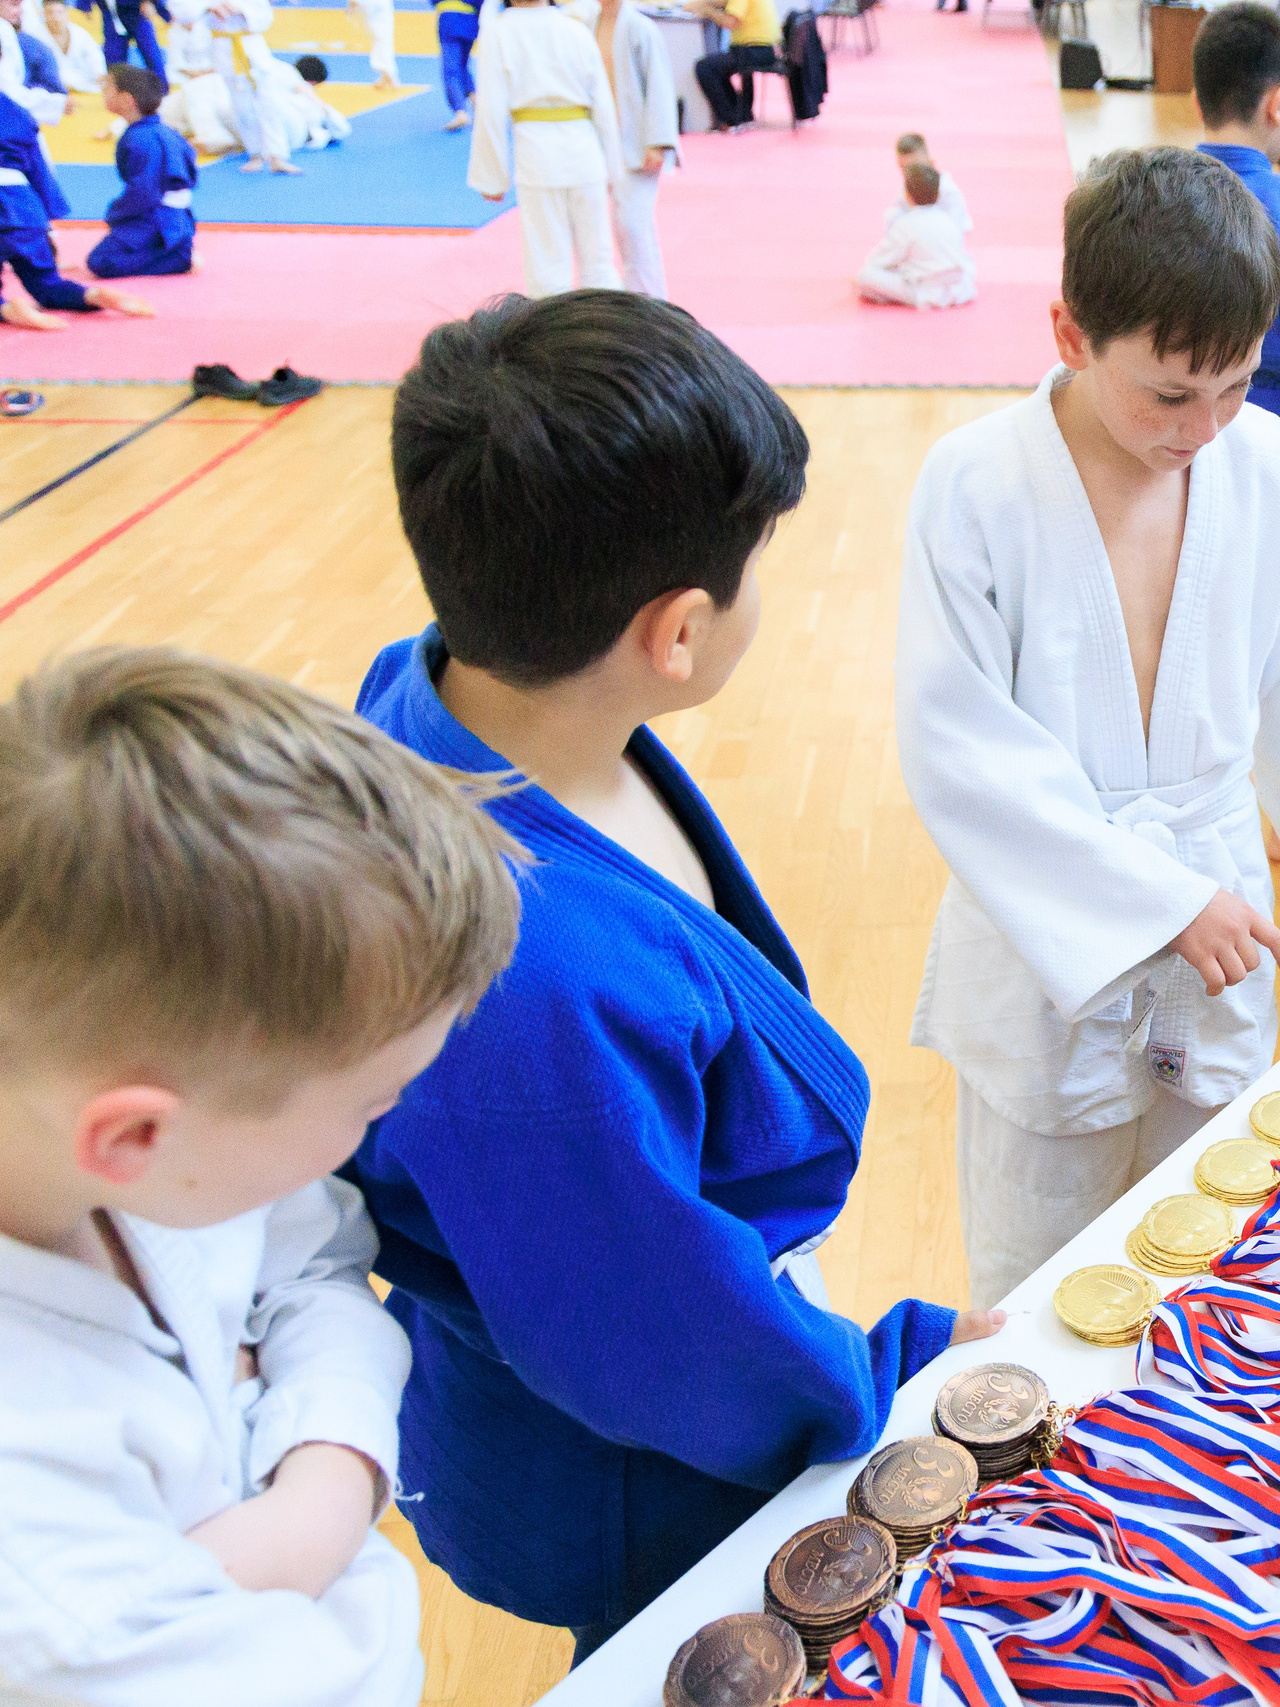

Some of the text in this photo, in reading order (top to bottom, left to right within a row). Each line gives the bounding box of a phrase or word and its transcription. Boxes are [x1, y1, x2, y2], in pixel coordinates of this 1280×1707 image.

[1151, 1048, 1183, 1058] APPROVED
[988, 1373, 1029, 1400] 3
[956, 1387, 987, 1423] МЕСТО
[913, 1447, 956, 1478] 3
[878, 1465, 911, 1505] МЕСТО
